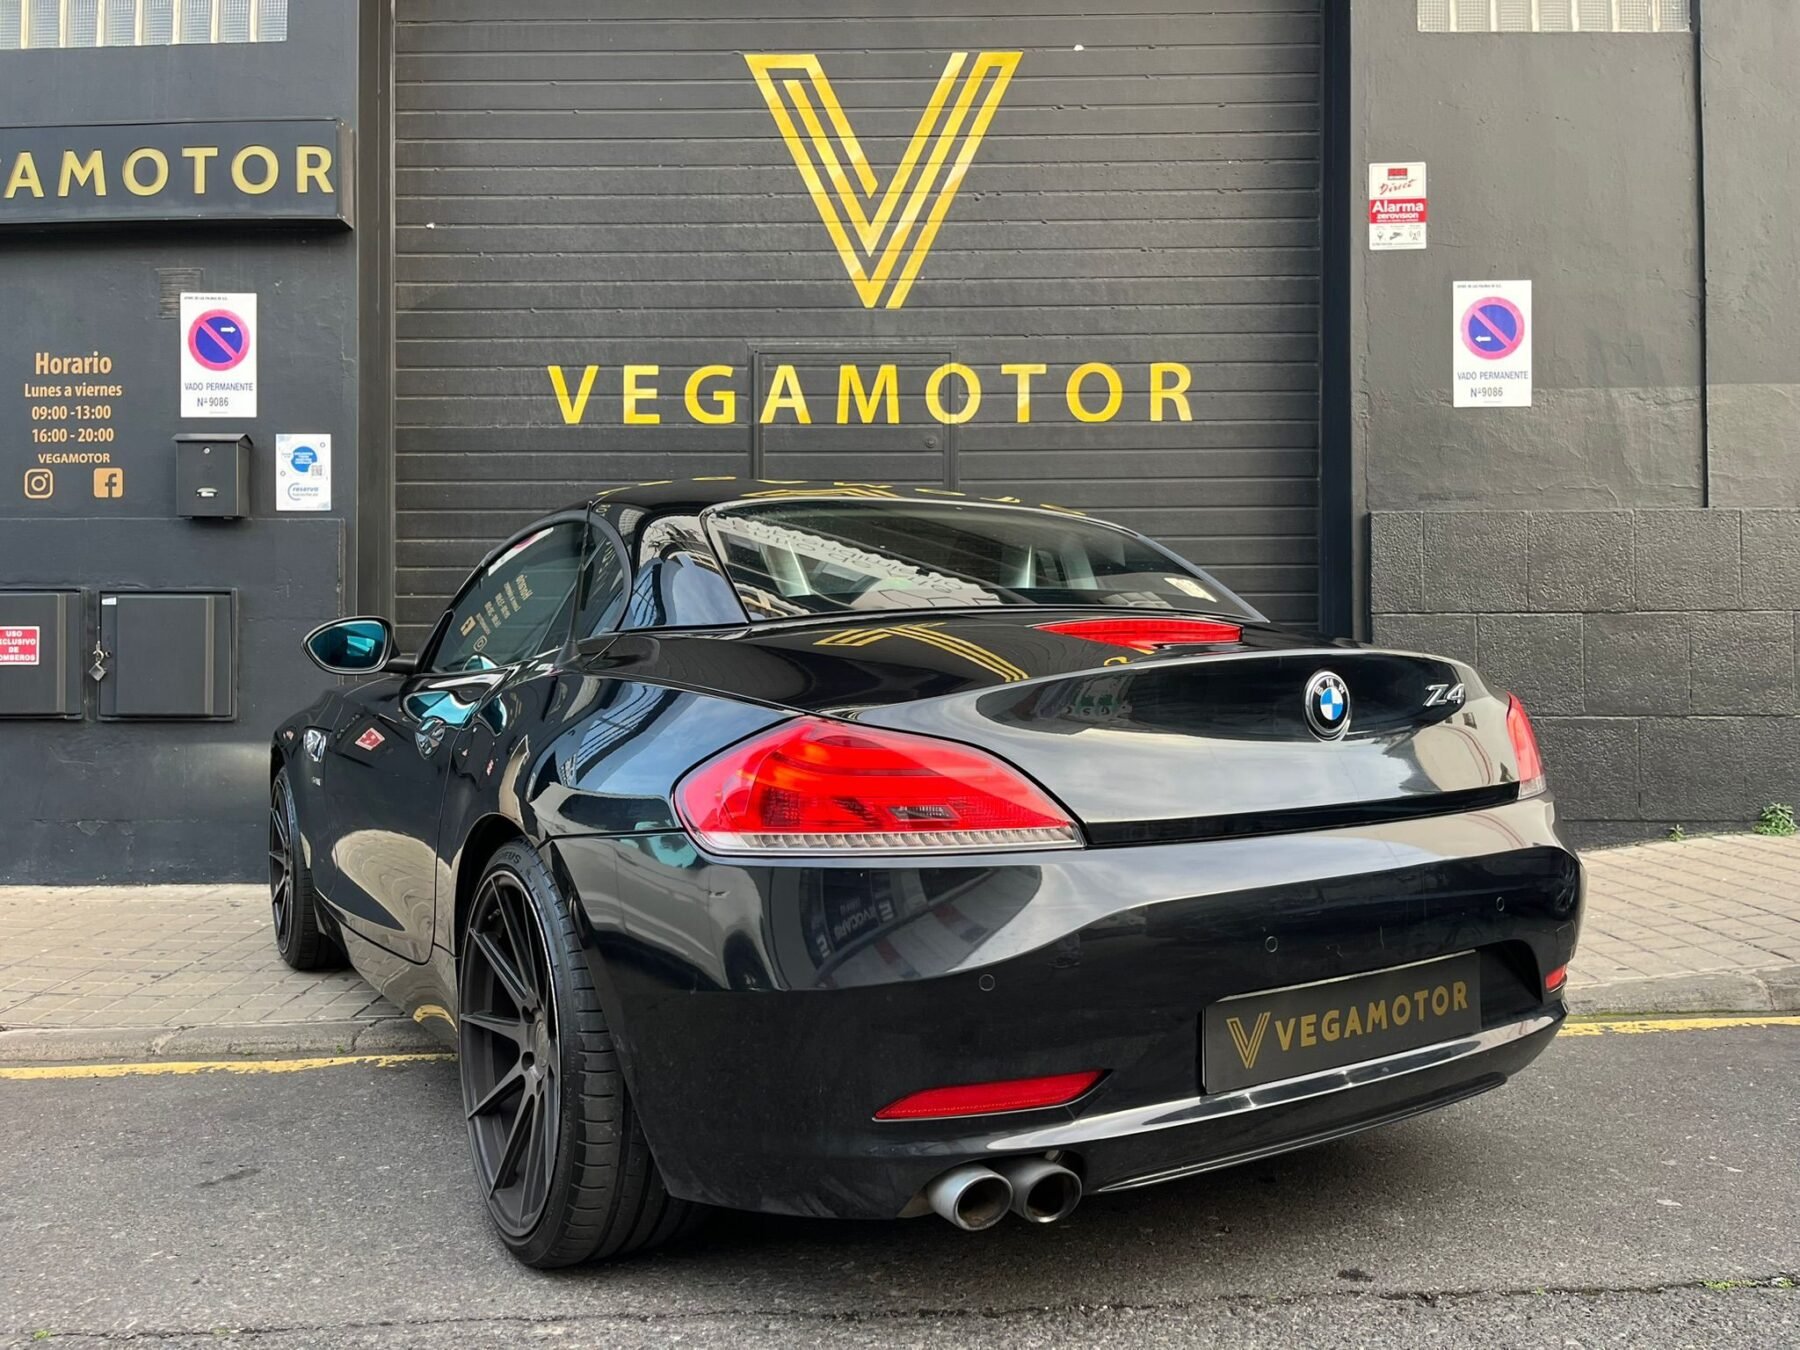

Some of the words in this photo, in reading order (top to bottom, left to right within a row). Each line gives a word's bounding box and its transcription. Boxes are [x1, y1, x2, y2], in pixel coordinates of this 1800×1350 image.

[0, 145, 334, 198] AMOTOR
[1371, 200, 1424, 213] Alarma
[35, 351, 112, 374] Horario
[1457, 371, 1477, 380] VADO
[1480, 371, 1528, 380] PERMANENTE
[25, 383, 61, 397] Lunes
[64, 386, 72, 396] a
[75, 382, 122, 396] viernes
[184, 382, 204, 391] VADO
[206, 382, 254, 391] PERMANENTE
[547, 363, 1193, 425] VEGAMOTOR
[31, 406, 67, 420] 09:00
[32, 428, 67, 442] 16:00
[77, 428, 114, 442] 20:00
[38, 453, 110, 464] VEGAMOTOR
[1314, 678, 1345, 696] BMW
[1423, 682, 1465, 707] Z4
[1275, 981, 1468, 1051] VEGAMOTOR
